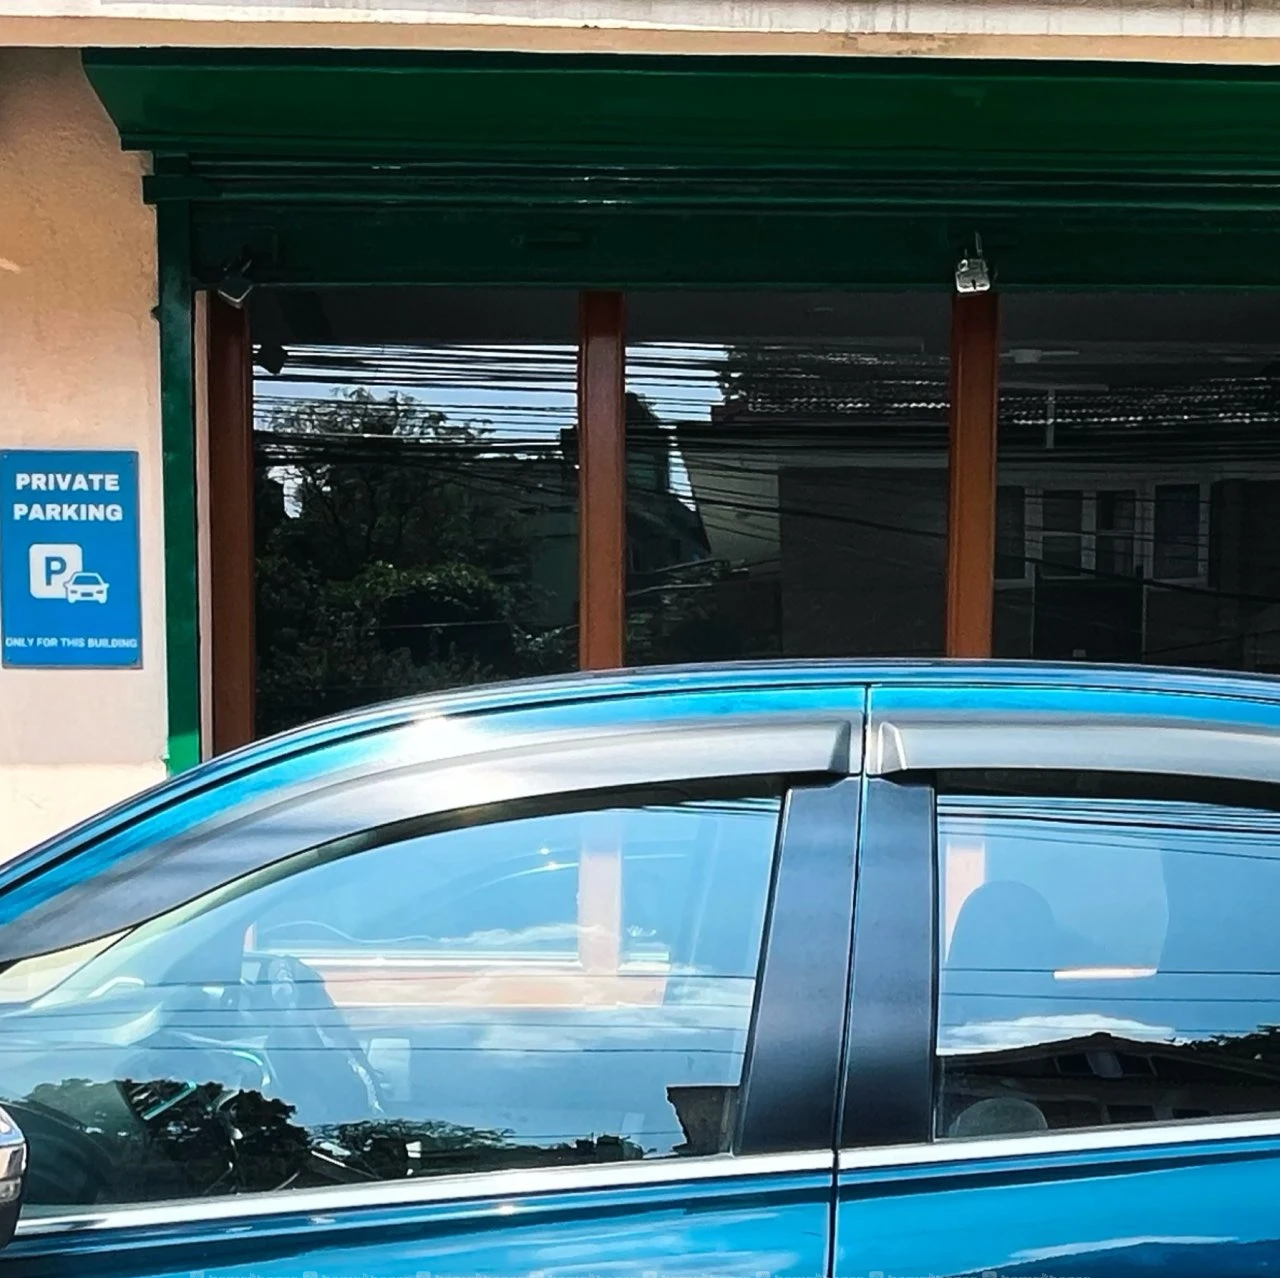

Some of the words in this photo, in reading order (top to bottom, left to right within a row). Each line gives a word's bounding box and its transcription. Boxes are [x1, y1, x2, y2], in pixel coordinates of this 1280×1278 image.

[15, 472, 119, 490] PRIVATE
[13, 503, 123, 520] PARKING
[5, 637, 34, 647] ONLY
[36, 637, 58, 647] FOR
[60, 637, 85, 648] THIS
[87, 638, 137, 648] BUILDING
